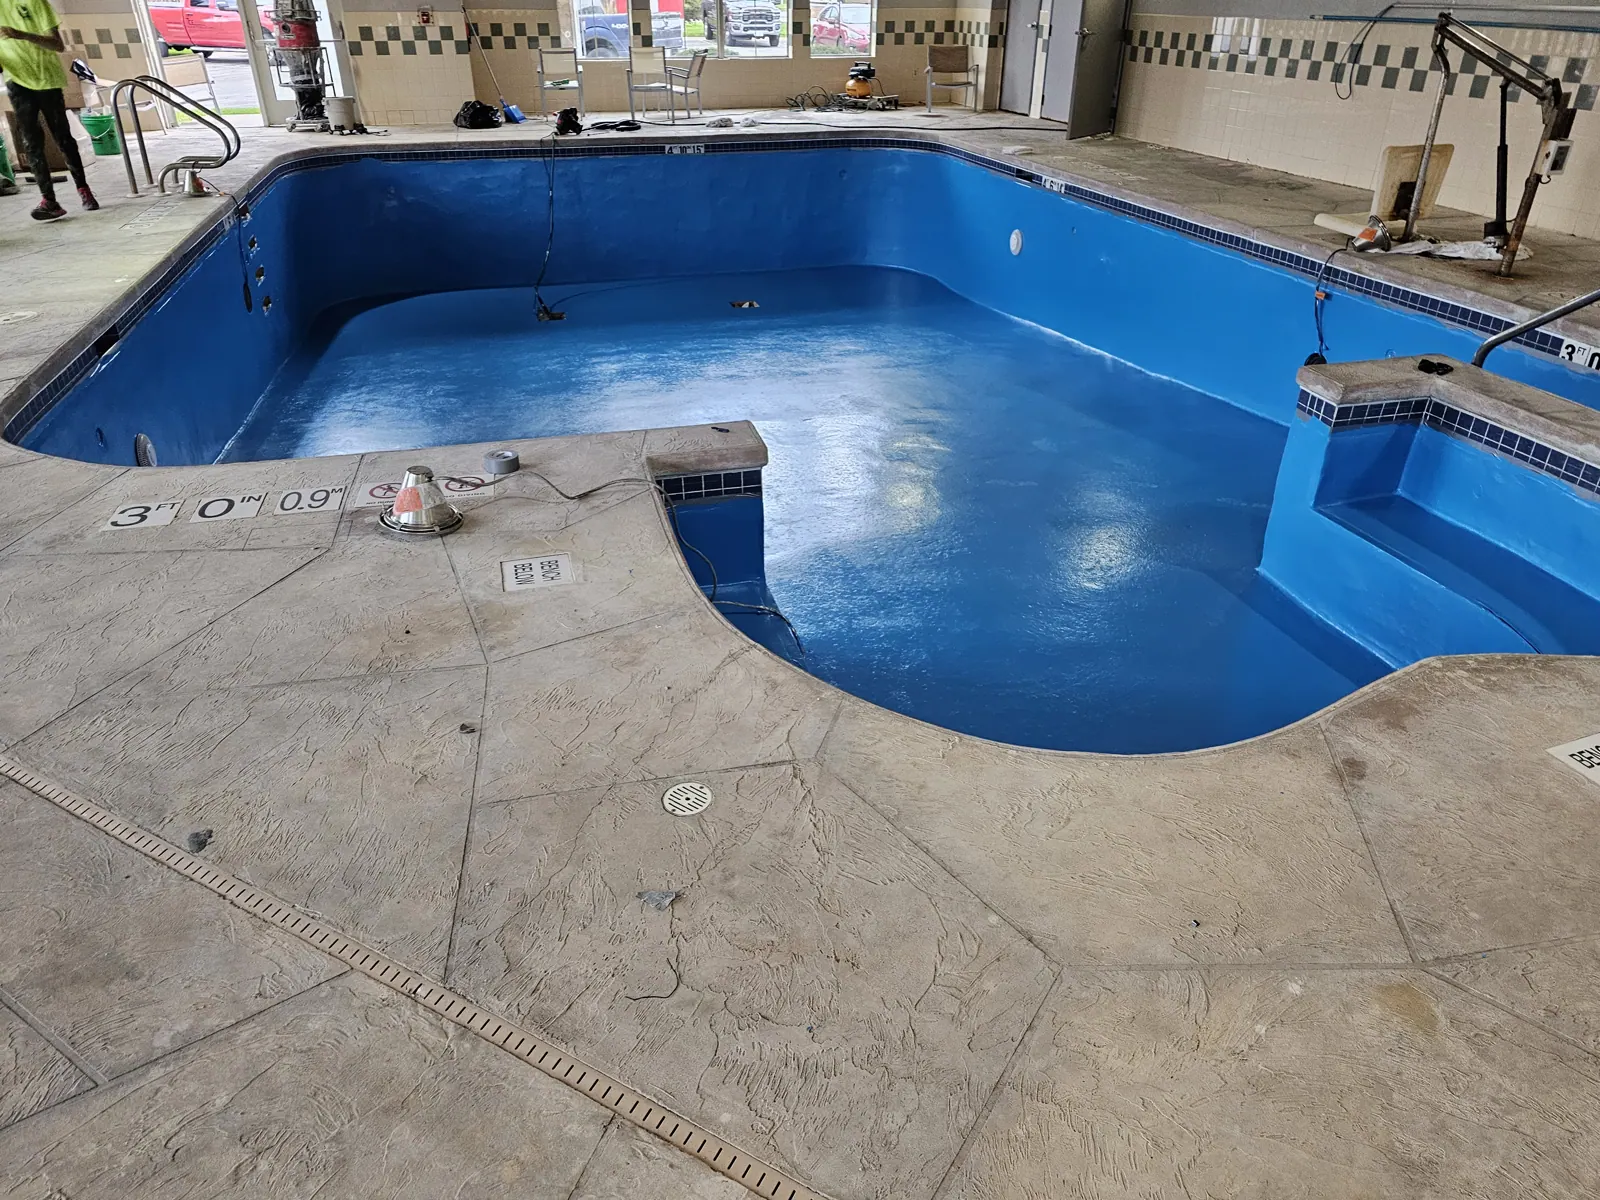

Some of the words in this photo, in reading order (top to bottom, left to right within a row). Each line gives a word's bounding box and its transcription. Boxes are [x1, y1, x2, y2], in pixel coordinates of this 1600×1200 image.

[1561, 343, 1576, 361] 3
[514, 563, 535, 585] BELOW
[540, 560, 561, 581] BENCH
[1568, 745, 1600, 769] BEN
